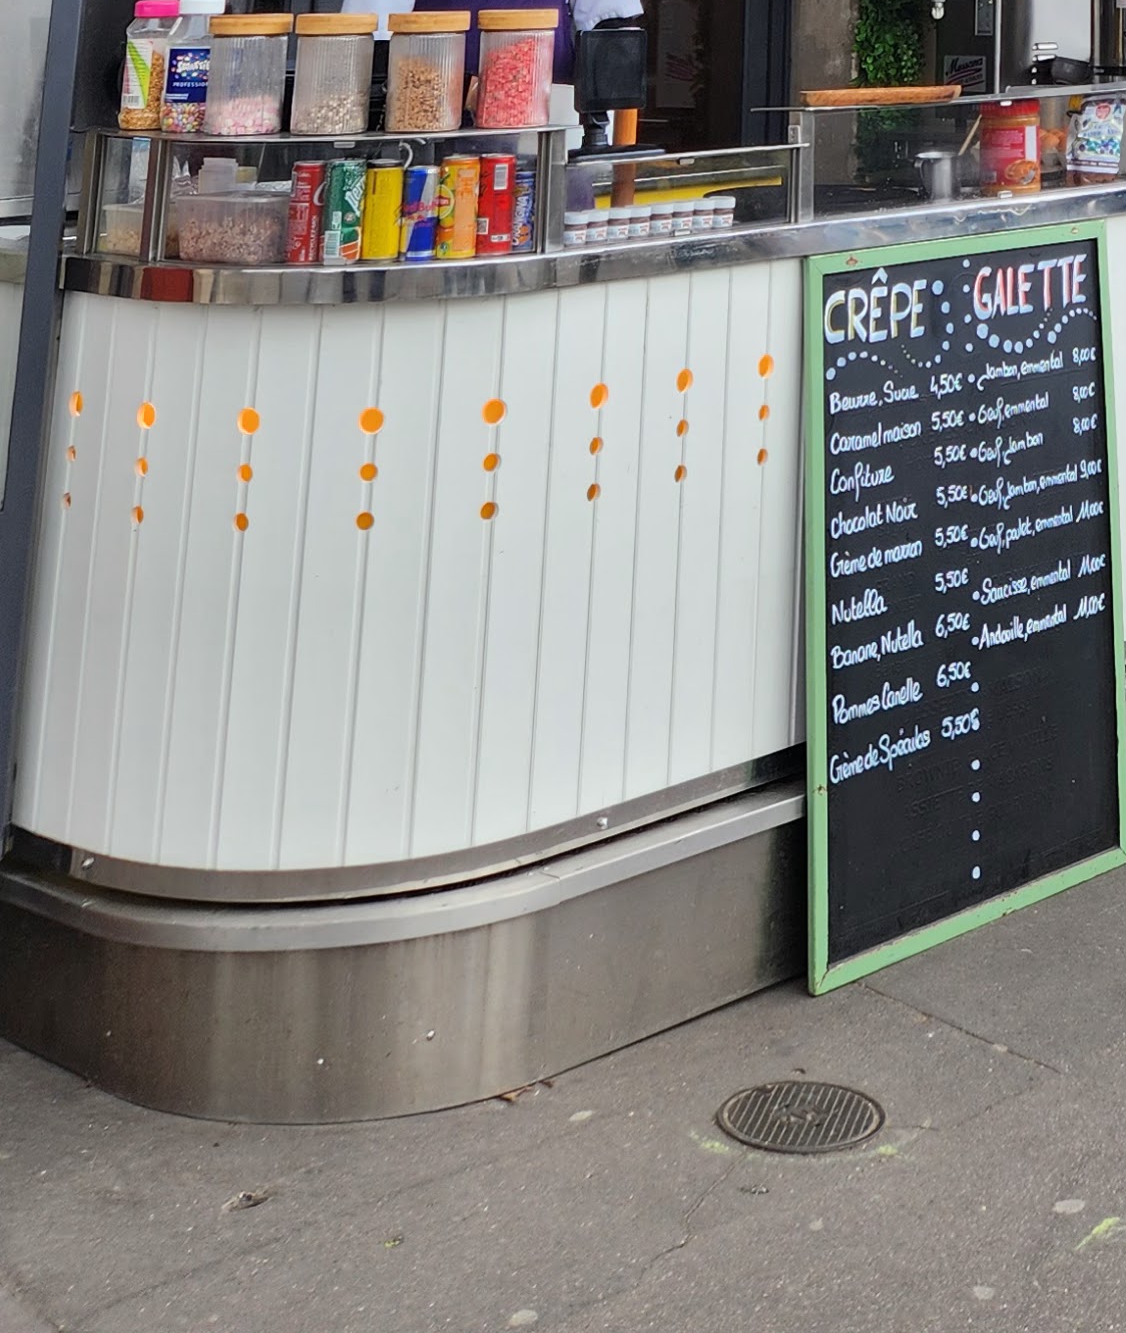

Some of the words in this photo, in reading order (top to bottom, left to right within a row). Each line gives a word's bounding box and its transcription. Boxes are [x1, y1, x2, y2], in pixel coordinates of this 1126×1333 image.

[825, 267, 928, 344] CRÊPE
[973, 254, 1087, 320] GALETTE
[930, 372, 964, 400] 4,50€
[829, 421, 882, 455] Caramel
[931, 409, 966, 433] 5,50€
[829, 461, 896, 503] Confiture
[934, 443, 967, 470] 5,50€
[936, 483, 968, 509] 5,50€
[867, 546, 883, 570] de
[934, 523, 969, 549] 5,50€
[831, 588, 888, 625] Nutella
[934, 567, 969, 595] 5,50€
[880, 619, 924, 655] Nutella
[935, 611, 971, 640] 6,50€
[936, 660, 972, 688] 6,50€
